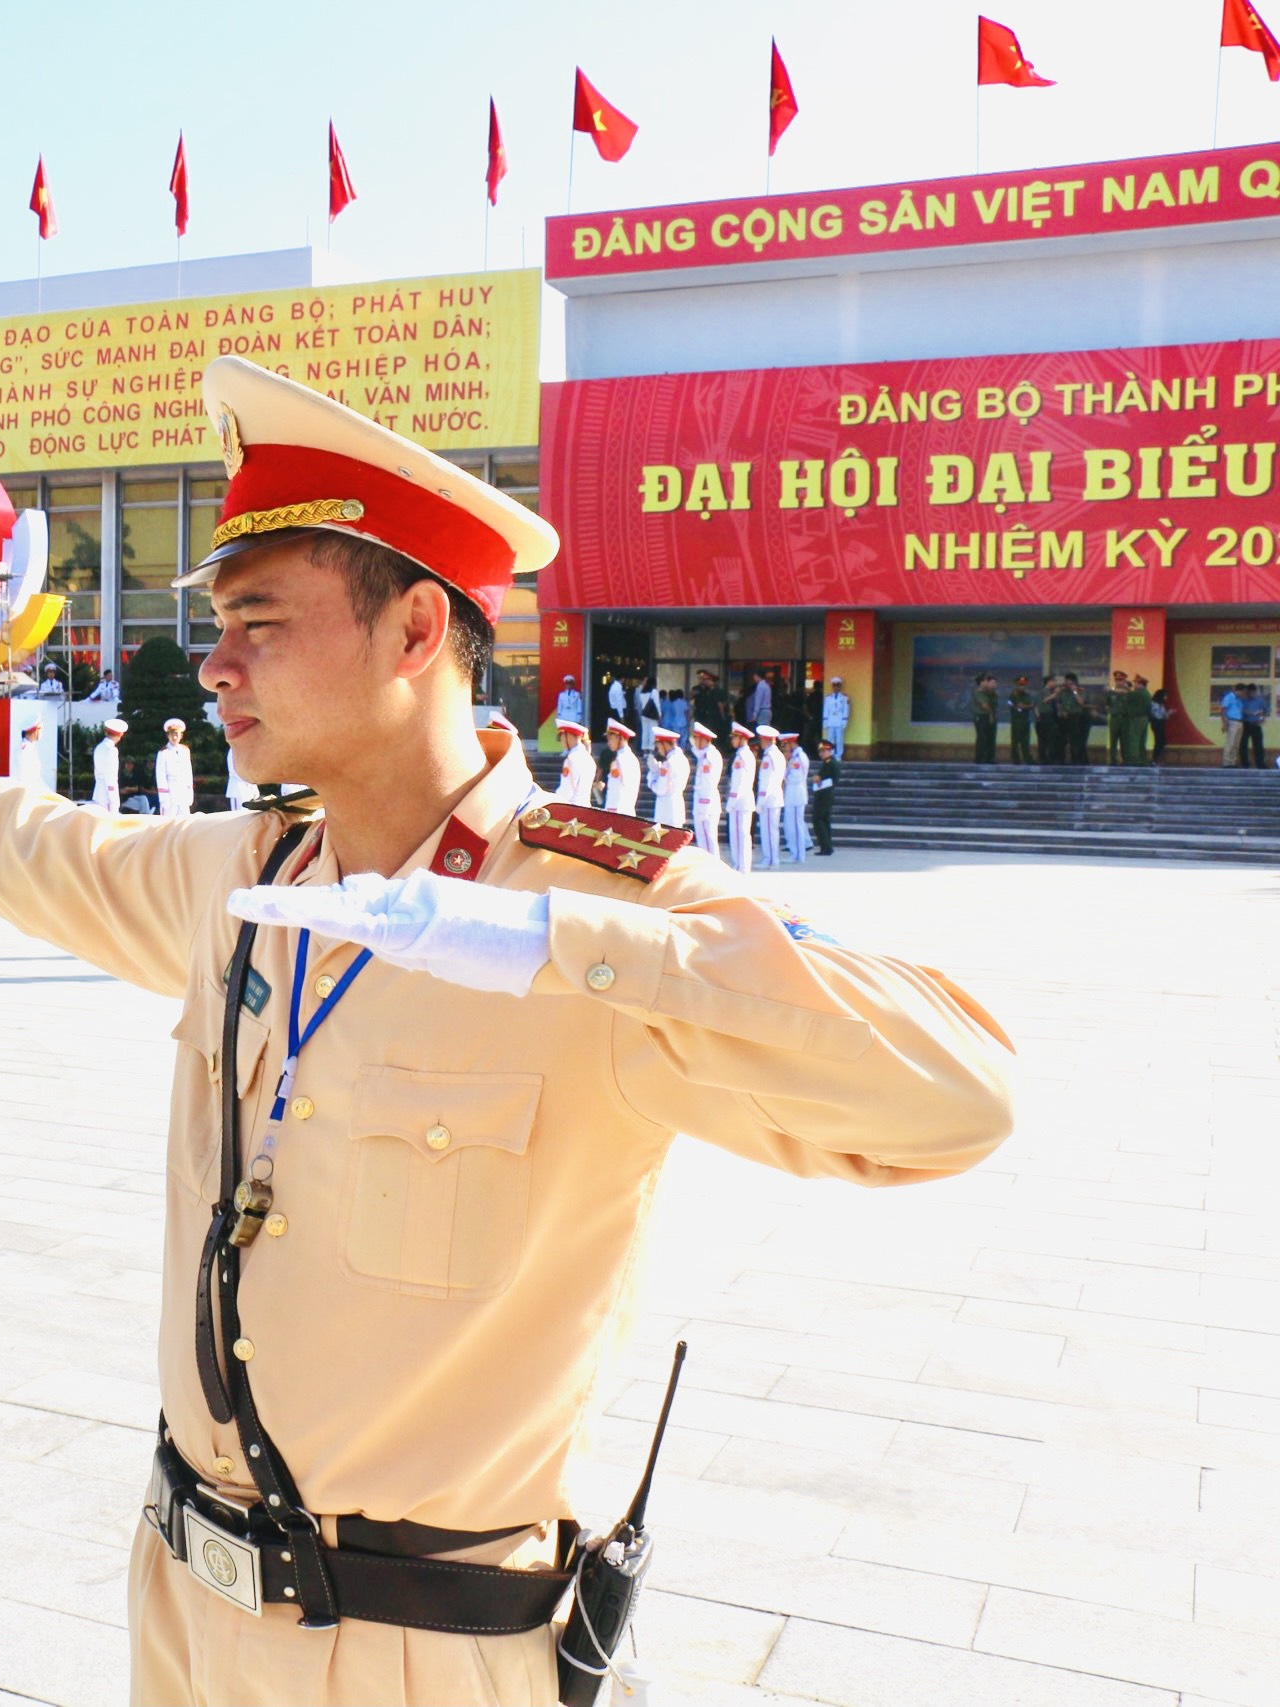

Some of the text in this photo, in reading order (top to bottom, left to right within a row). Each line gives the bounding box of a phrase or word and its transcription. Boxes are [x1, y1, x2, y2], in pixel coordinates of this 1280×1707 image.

[572, 216, 696, 261] ĐẢNG
[711, 204, 843, 253] CỘNG
[859, 190, 956, 237] SẢN
[972, 179, 1084, 228] VIỆT
[1101, 165, 1219, 213] NAM
[4, 324, 51, 347] ĐẠO
[64, 316, 111, 340] CỦA
[126, 310, 189, 334] TOÀN
[205, 303, 275, 328] ĐẢNG
[353, 288, 422, 315] PHÁT
[440, 286, 494, 306] HUY
[40, 346, 84, 370] SỨC
[96, 343, 156, 367] MẠNH
[169, 339, 206, 360] ĐẠI
[218, 331, 282, 355] ĐOÀN
[355, 319, 418, 344] TOÀN
[433, 317, 491, 340] DÂN;
[112, 366, 203, 396] NGHIỆP
[307, 357, 407, 380] NGHIỆP
[424, 349, 491, 372] HÓA,
[838, 383, 962, 426] ĐẢNG
[978, 380, 1042, 425] BỘ
[1056, 369, 1217, 416] THÀNH
[83, 397, 142, 423] CÔNG
[364, 381, 412, 405] VĂN
[425, 381, 490, 402] MINH,
[29, 427, 86, 457] ĐỘNG
[98, 426, 140, 452] LỰC
[152, 423, 206, 447] PHÁT
[412, 410, 490, 433] NƯỚC.
[639, 423, 1276, 521] ĐẠI HỘI ĐẠI BIỂU
[905, 517, 1280, 579] NHIỆM KỲ 20
